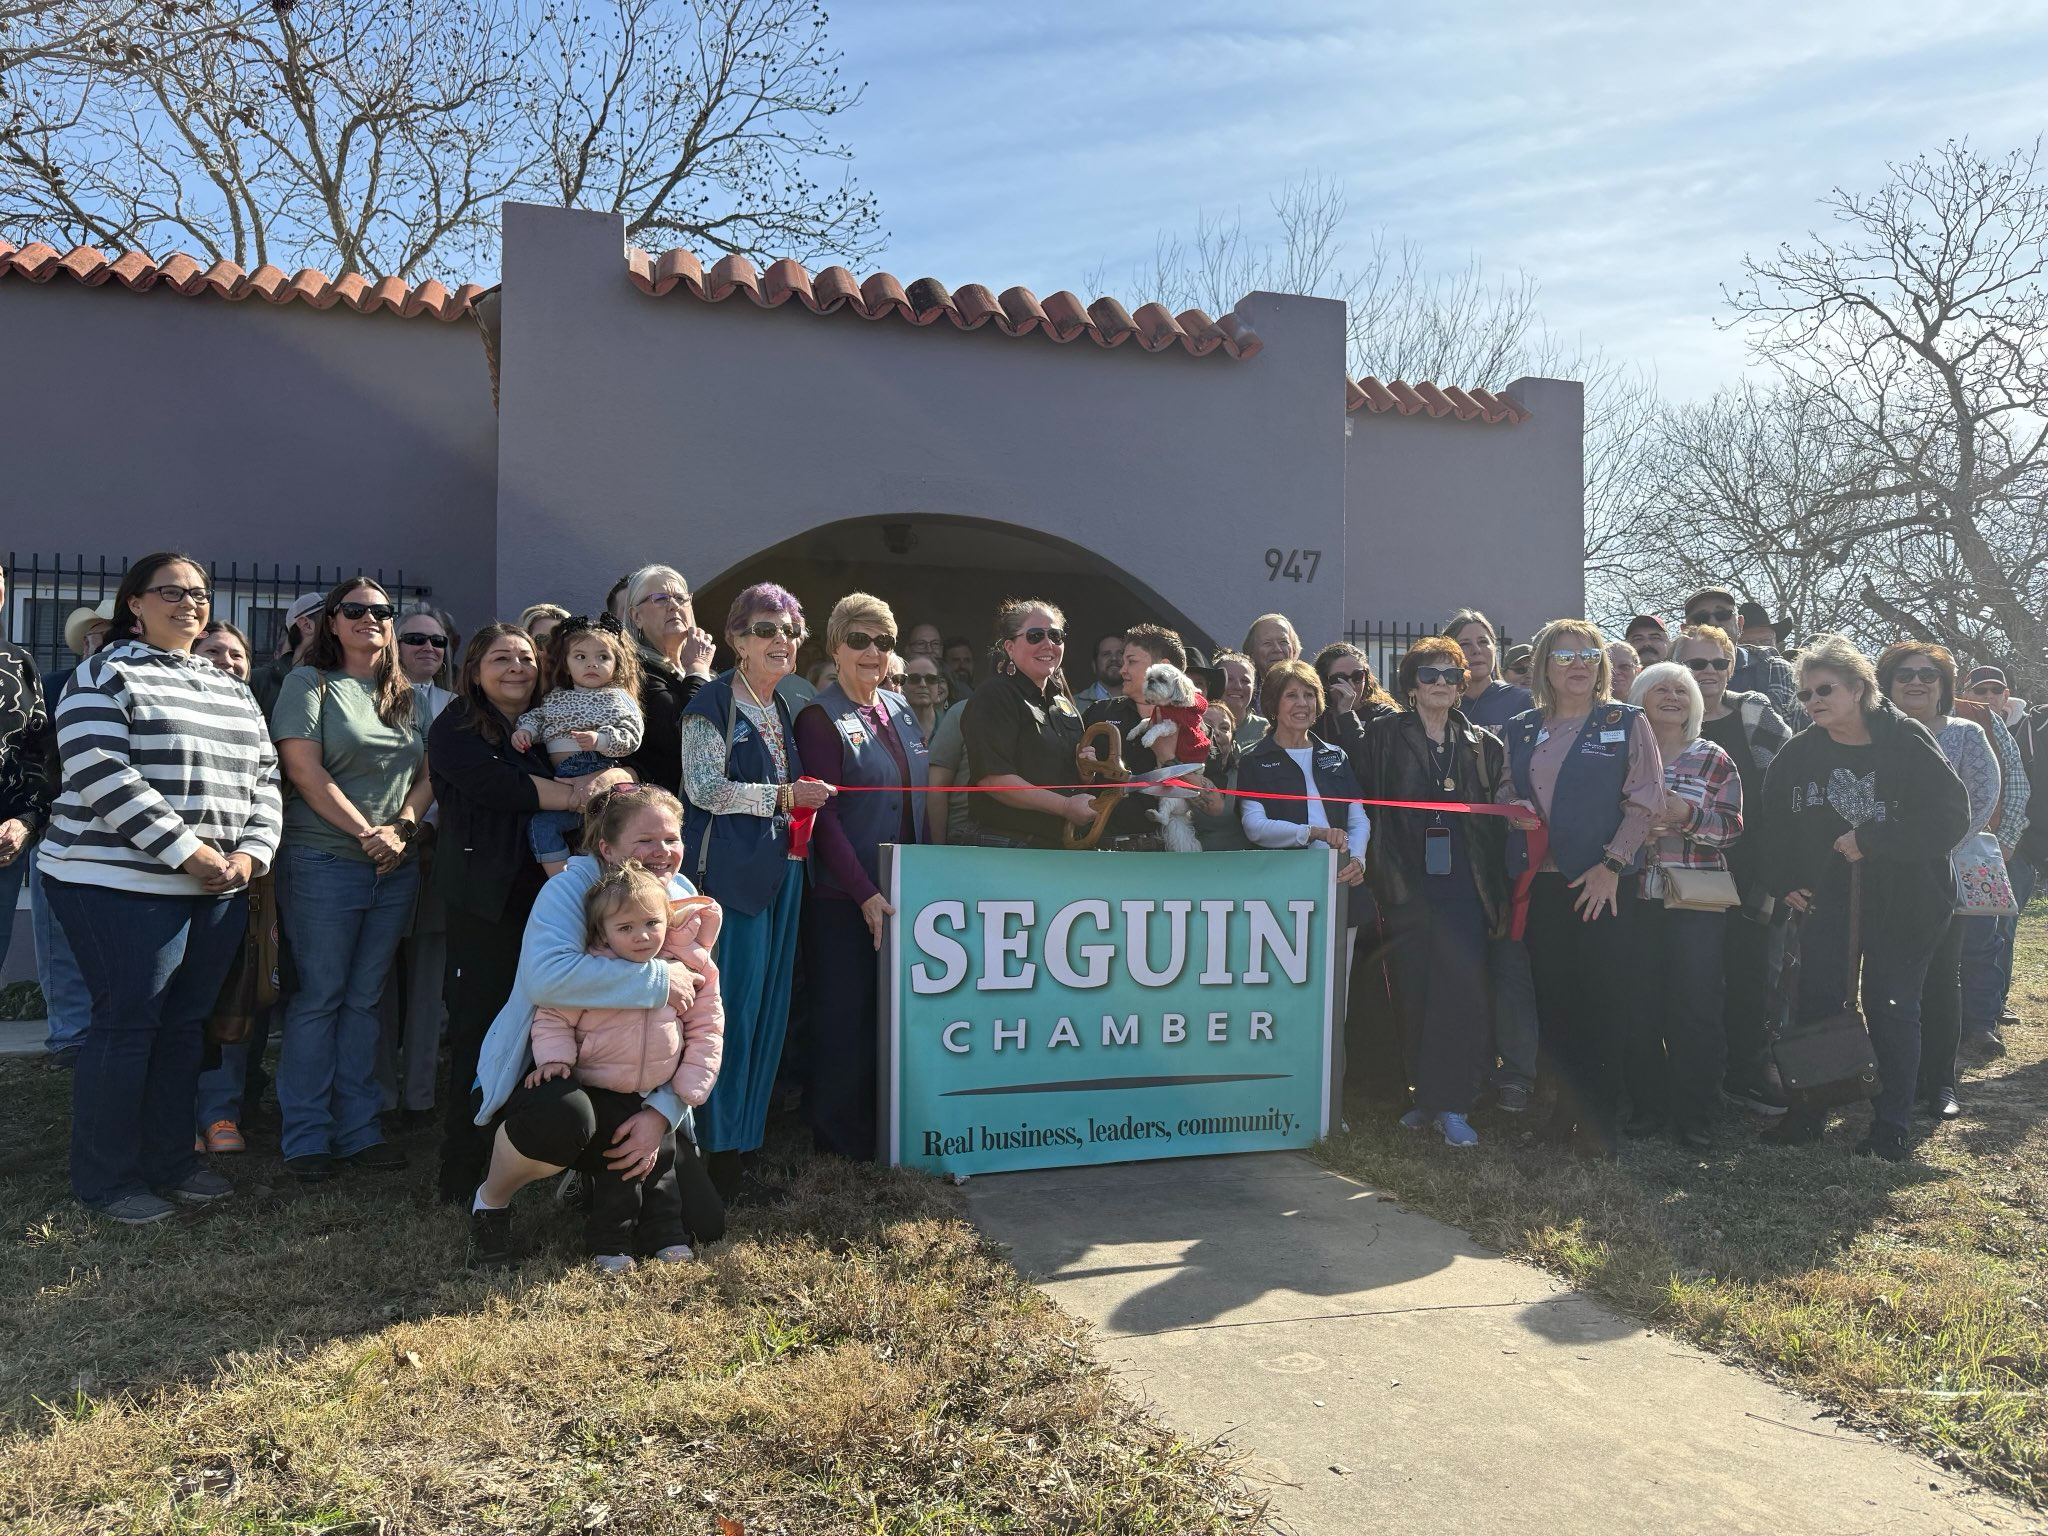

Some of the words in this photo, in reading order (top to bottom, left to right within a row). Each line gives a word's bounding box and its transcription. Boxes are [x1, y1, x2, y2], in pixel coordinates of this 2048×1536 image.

[1264, 548, 1322, 584] 947
[910, 898, 1316, 995] SEGUIN
[942, 1011, 1274, 1053] CHAMBER
[921, 1126, 975, 1157] Real
[980, 1122, 1083, 1151] business,
[1087, 1115, 1172, 1144] leaders,
[1177, 1107, 1301, 1137] community.
